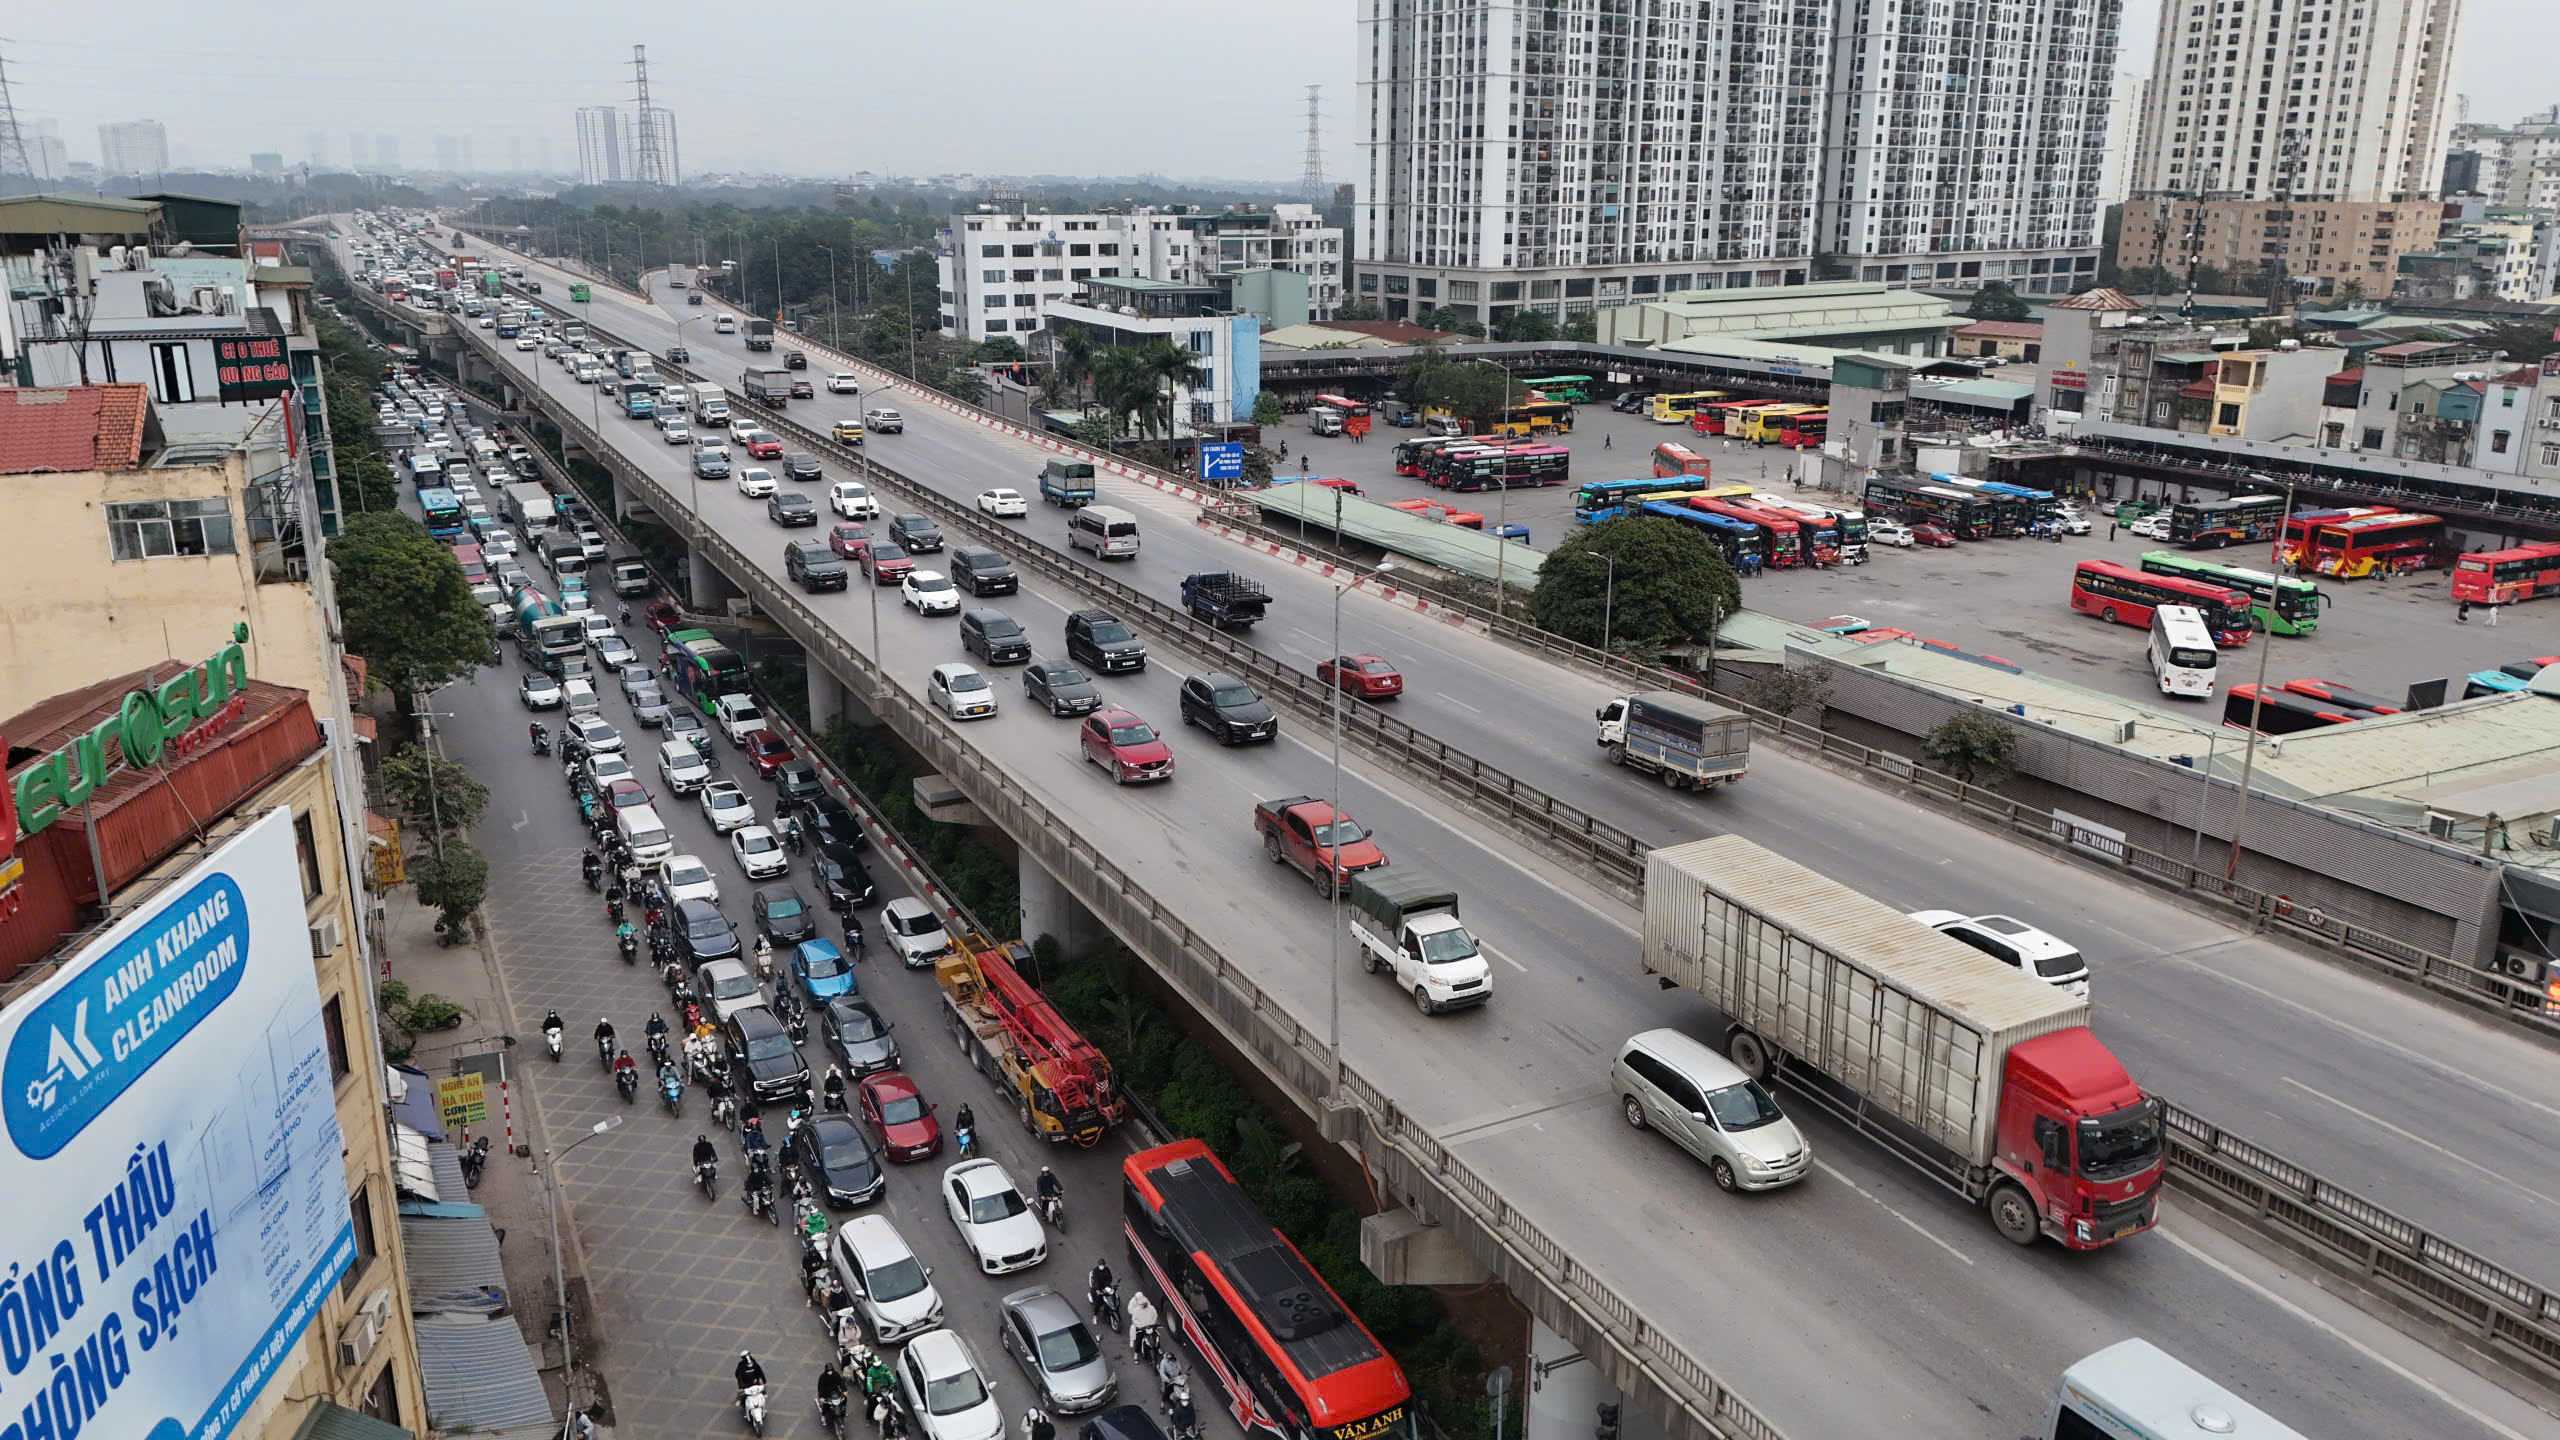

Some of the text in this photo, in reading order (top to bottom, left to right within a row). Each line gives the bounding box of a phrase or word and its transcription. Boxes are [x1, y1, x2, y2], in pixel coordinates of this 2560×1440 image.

[248, 337, 280, 358] THUÊ
[264, 360, 288, 381] CÁO
[103, 889, 230, 1014] ANH KHANG
[111, 934, 238, 1063] CLEANROOM
[287, 1067, 300, 1084] ISO
[83, 1140, 175, 1284] THẦU
[0, 1239, 84, 1376] ỔNG
[132, 1207, 217, 1352] SẠCH
[220, 1405, 231, 1424] TY
[285, 1300, 306, 1338] PHÒNG
[304, 1281, 322, 1309] SẠCH
[1334, 1408, 1404, 1440] VÂN ANH
